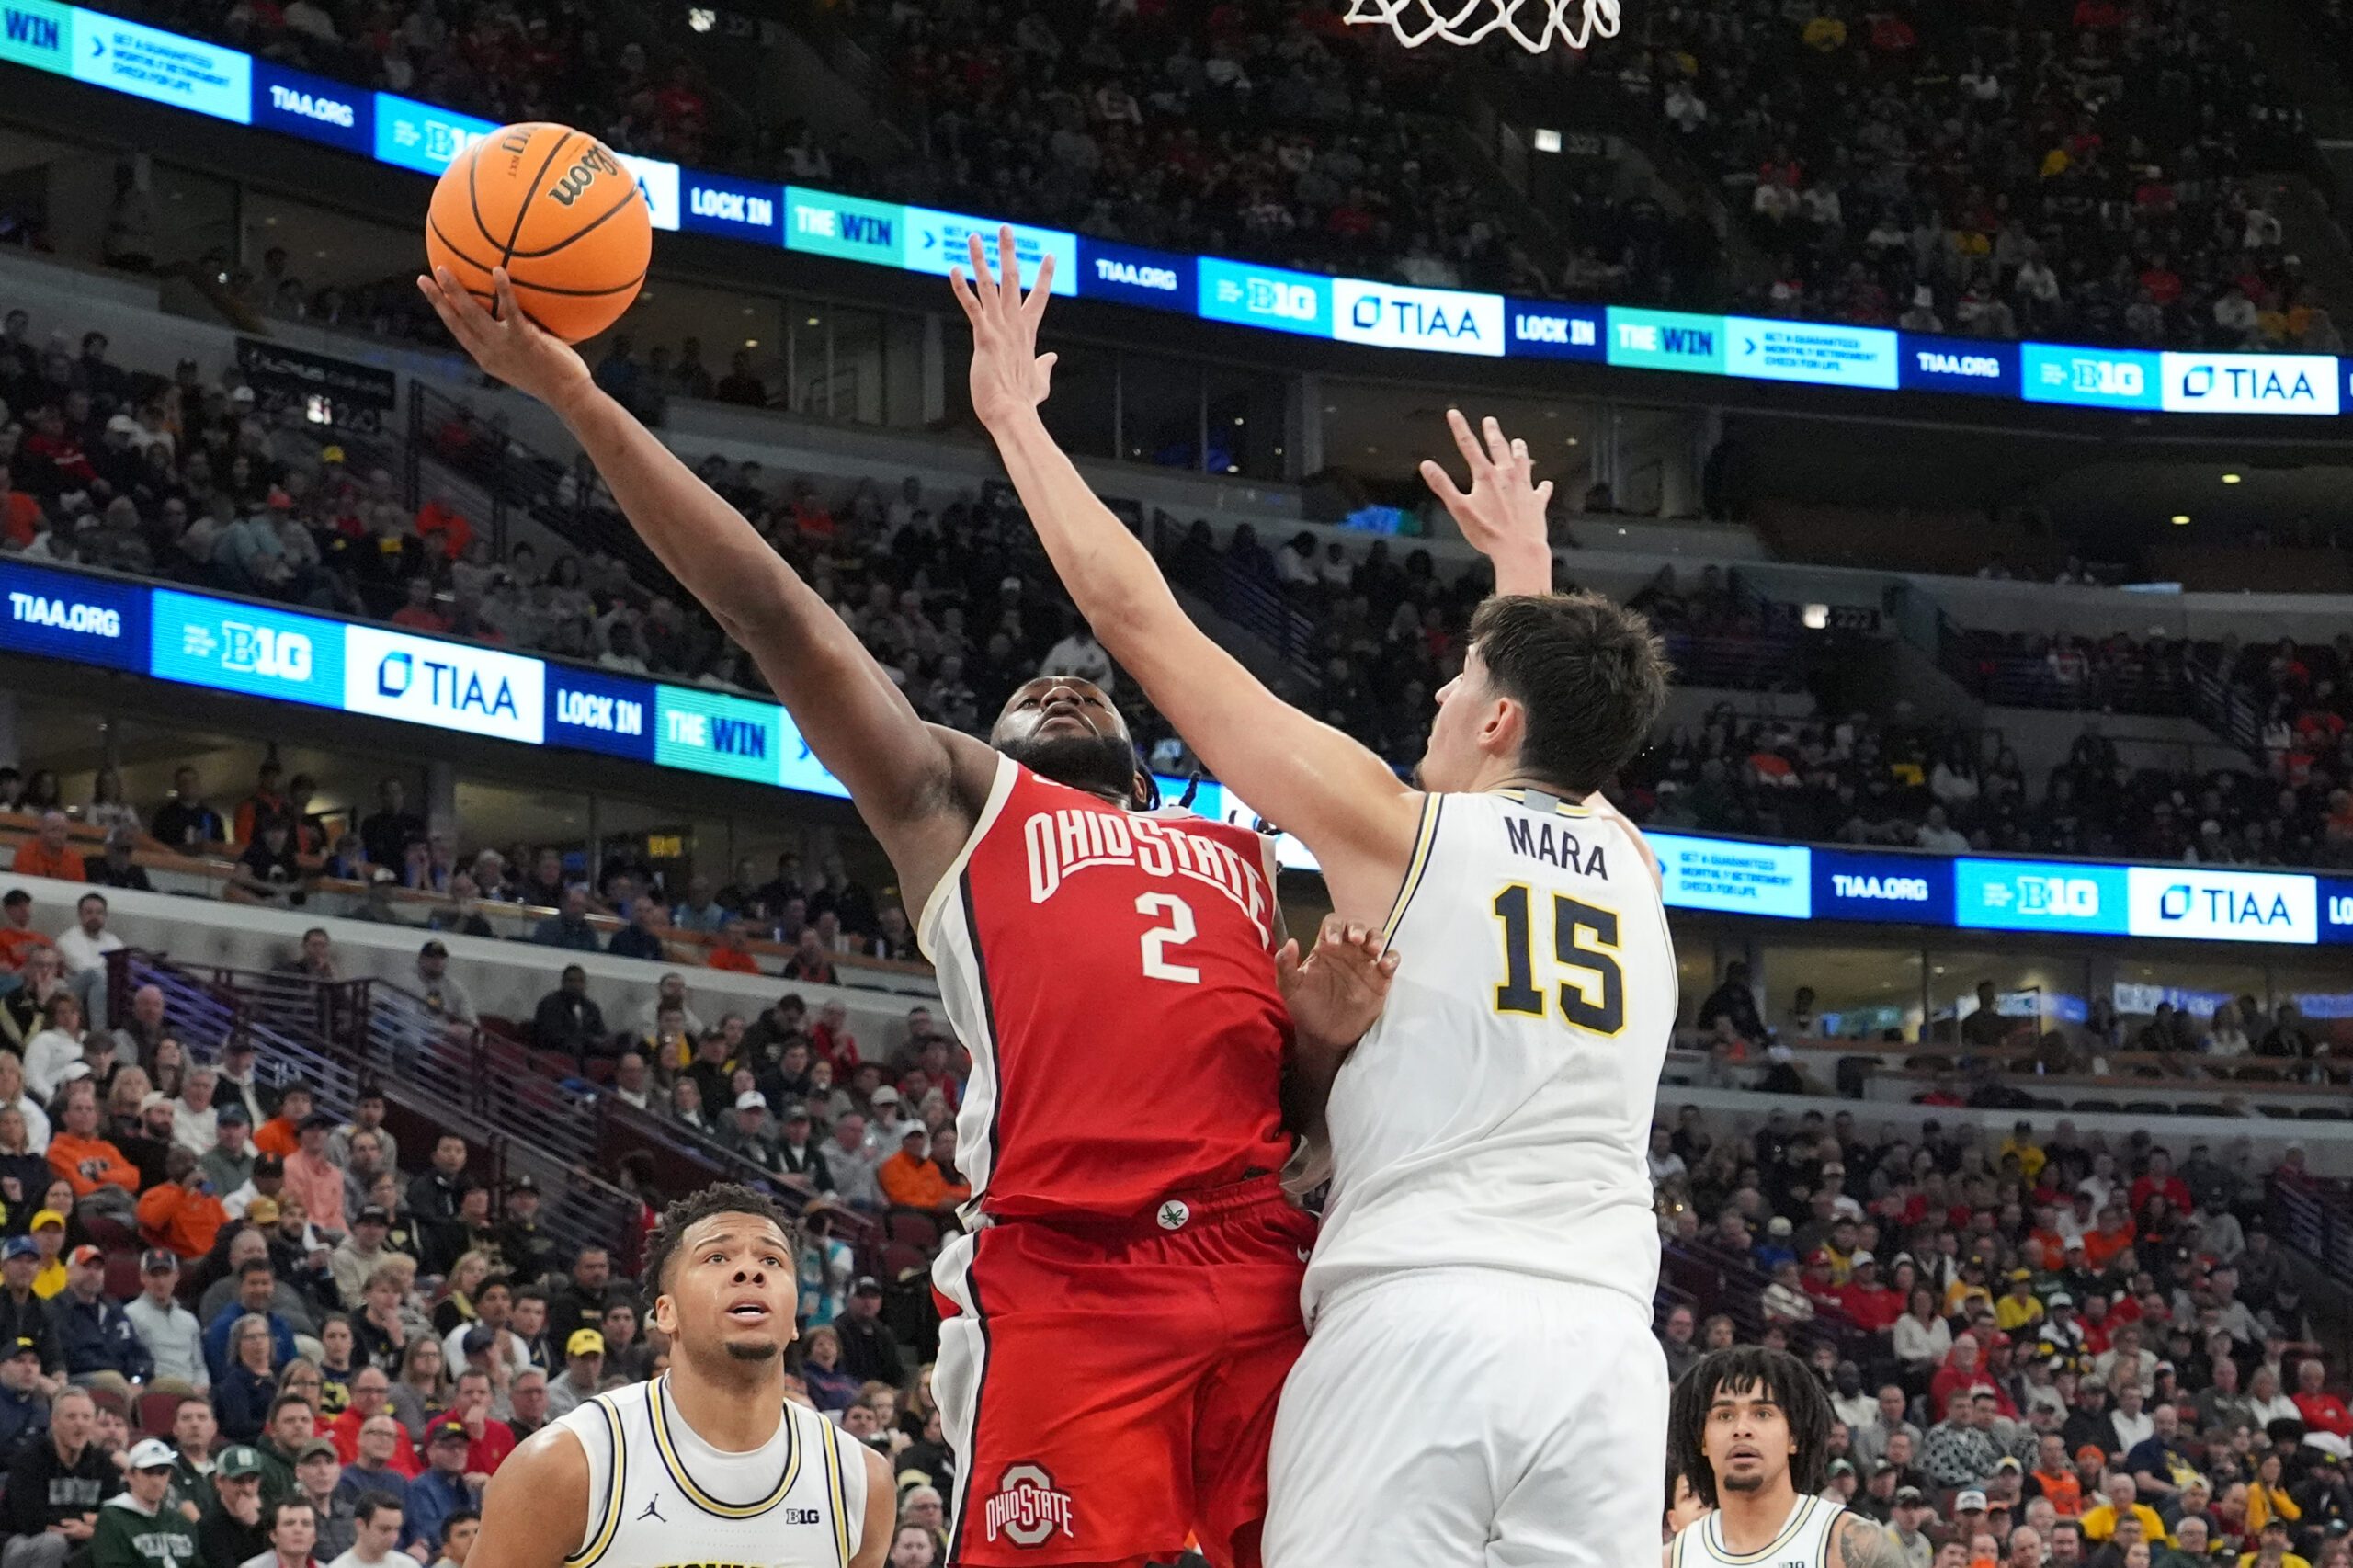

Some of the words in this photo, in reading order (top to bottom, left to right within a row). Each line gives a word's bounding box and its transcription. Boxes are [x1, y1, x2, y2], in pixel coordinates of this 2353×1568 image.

[4, 7, 59, 51] WIN
[270, 85, 354, 128] TIAA.ORG
[691, 187, 745, 222] LOCK
[746, 197, 773, 226] IN
[794, 205, 836, 237] THE
[840, 211, 892, 248] WIN
[1096, 258, 1177, 290] TIAA.ORG
[1391, 301, 1481, 340] TIAA
[1516, 314, 1568, 343] LOCK
[1570, 319, 1596, 346] IN
[1617, 324, 1657, 351] THE
[1661, 326, 1713, 357] WIN
[1916, 352, 2000, 378] TIAA.ORG
[2225, 369, 2314, 401] TIAA
[9, 591, 120, 637] TIAA.ORG
[423, 660, 518, 720] TIAA
[557, 688, 613, 731] LOCK
[615, 699, 642, 736] IN
[665, 709, 706, 747] THE
[710, 715, 766, 760] WIN
[1504, 816, 1608, 881] MARA
[1832, 874, 1929, 902] TIAA.ORG
[2202, 888, 2292, 926] TIAA
[1134, 892, 1201, 984] 2
[1492, 881, 1627, 1039] 15
